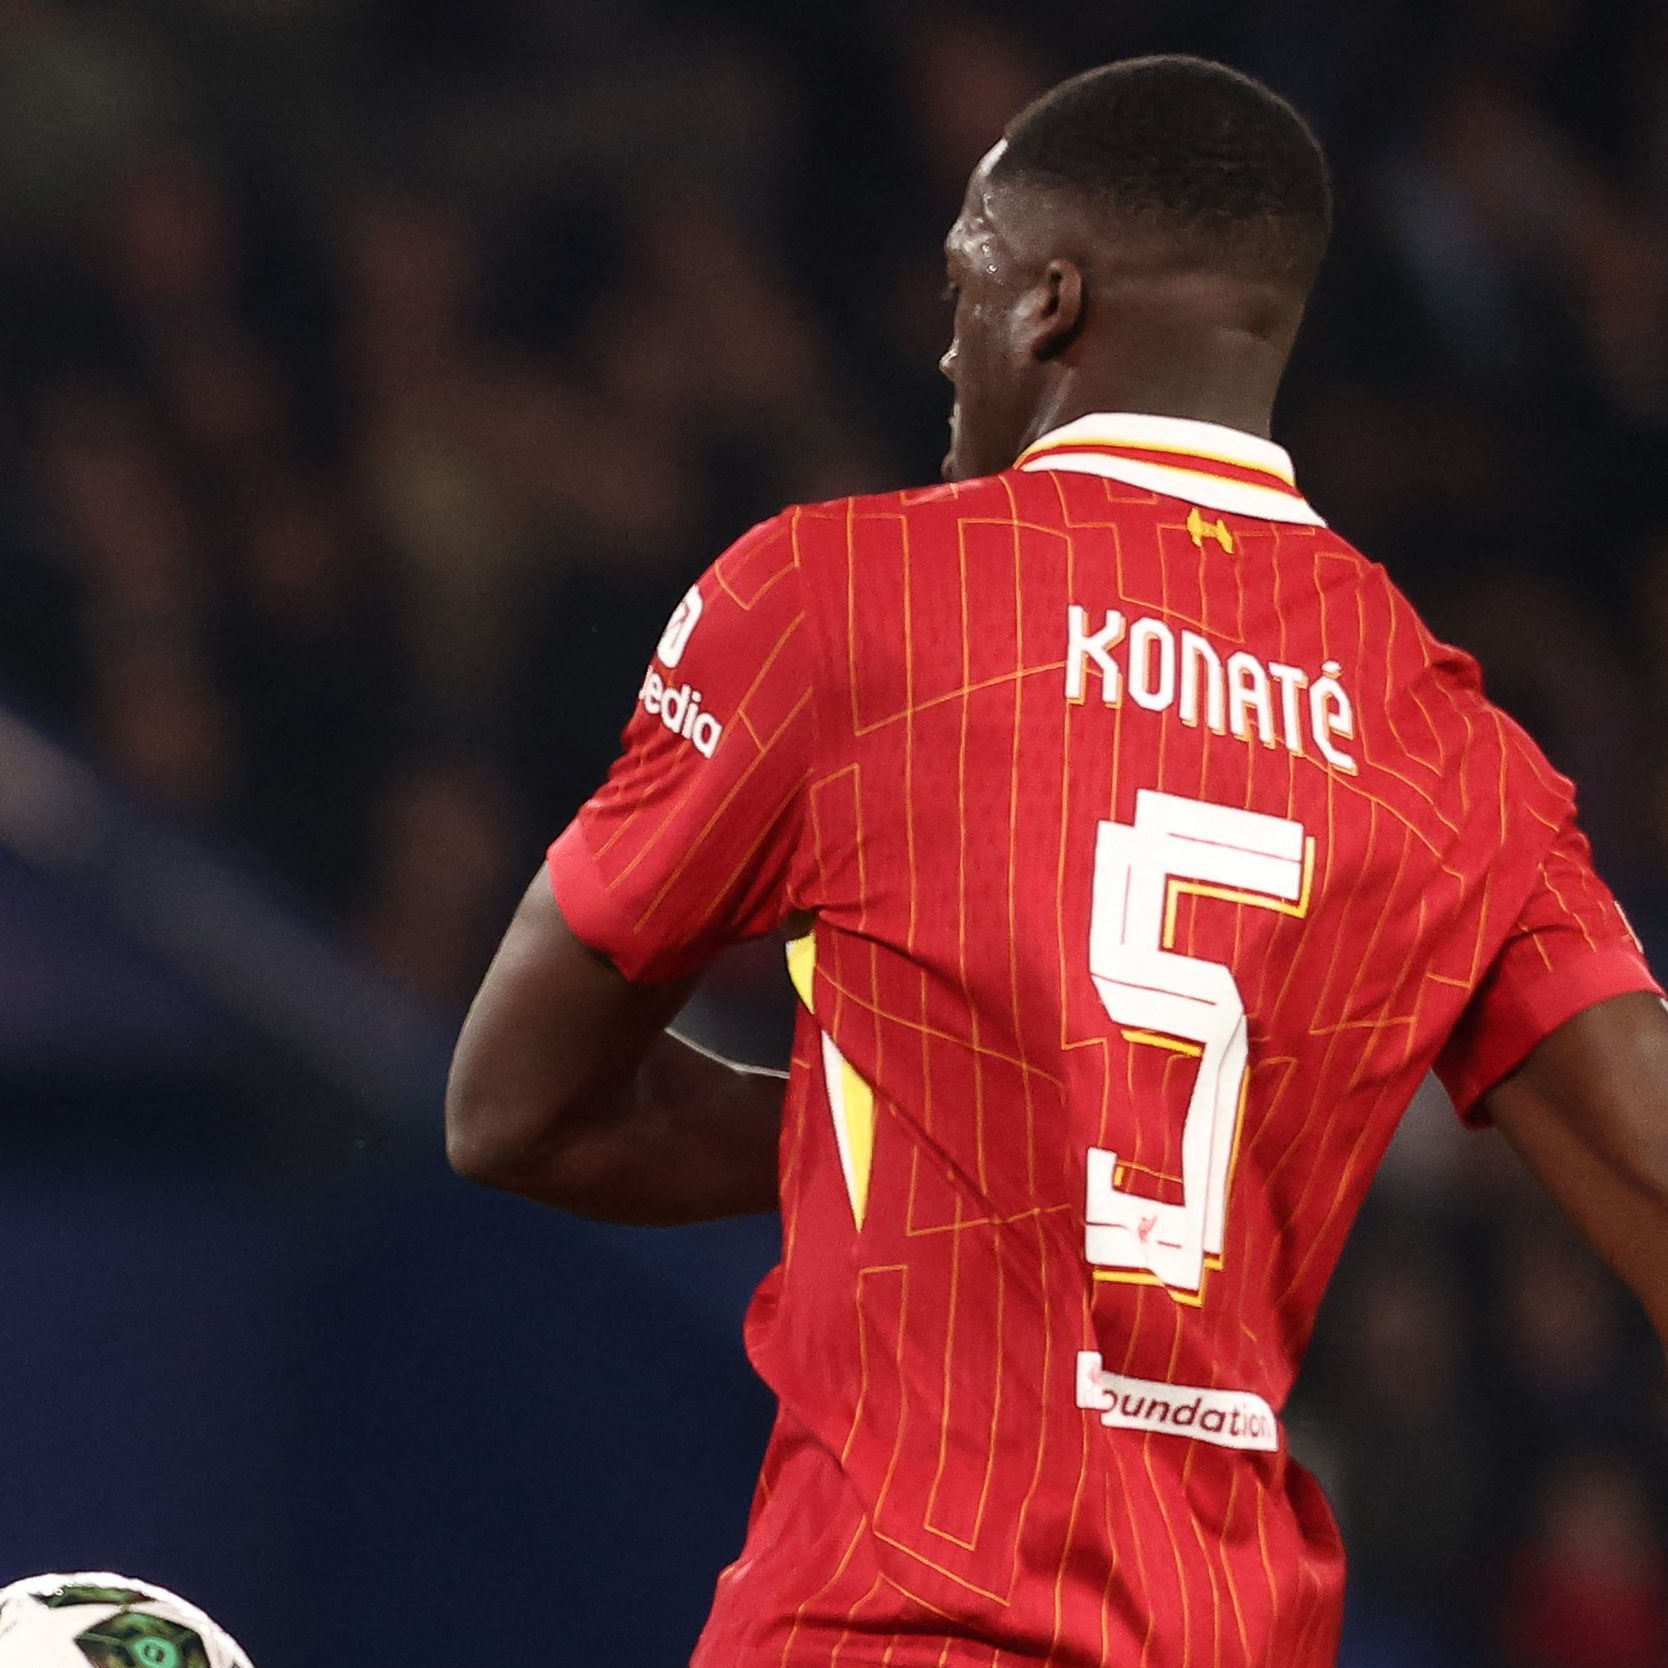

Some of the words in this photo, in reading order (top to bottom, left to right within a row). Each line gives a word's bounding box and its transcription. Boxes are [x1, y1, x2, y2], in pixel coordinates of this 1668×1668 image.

[639, 664, 724, 760] edia
[1085, 787, 1316, 1307] 5
[1101, 1389, 1270, 1438] oundation
